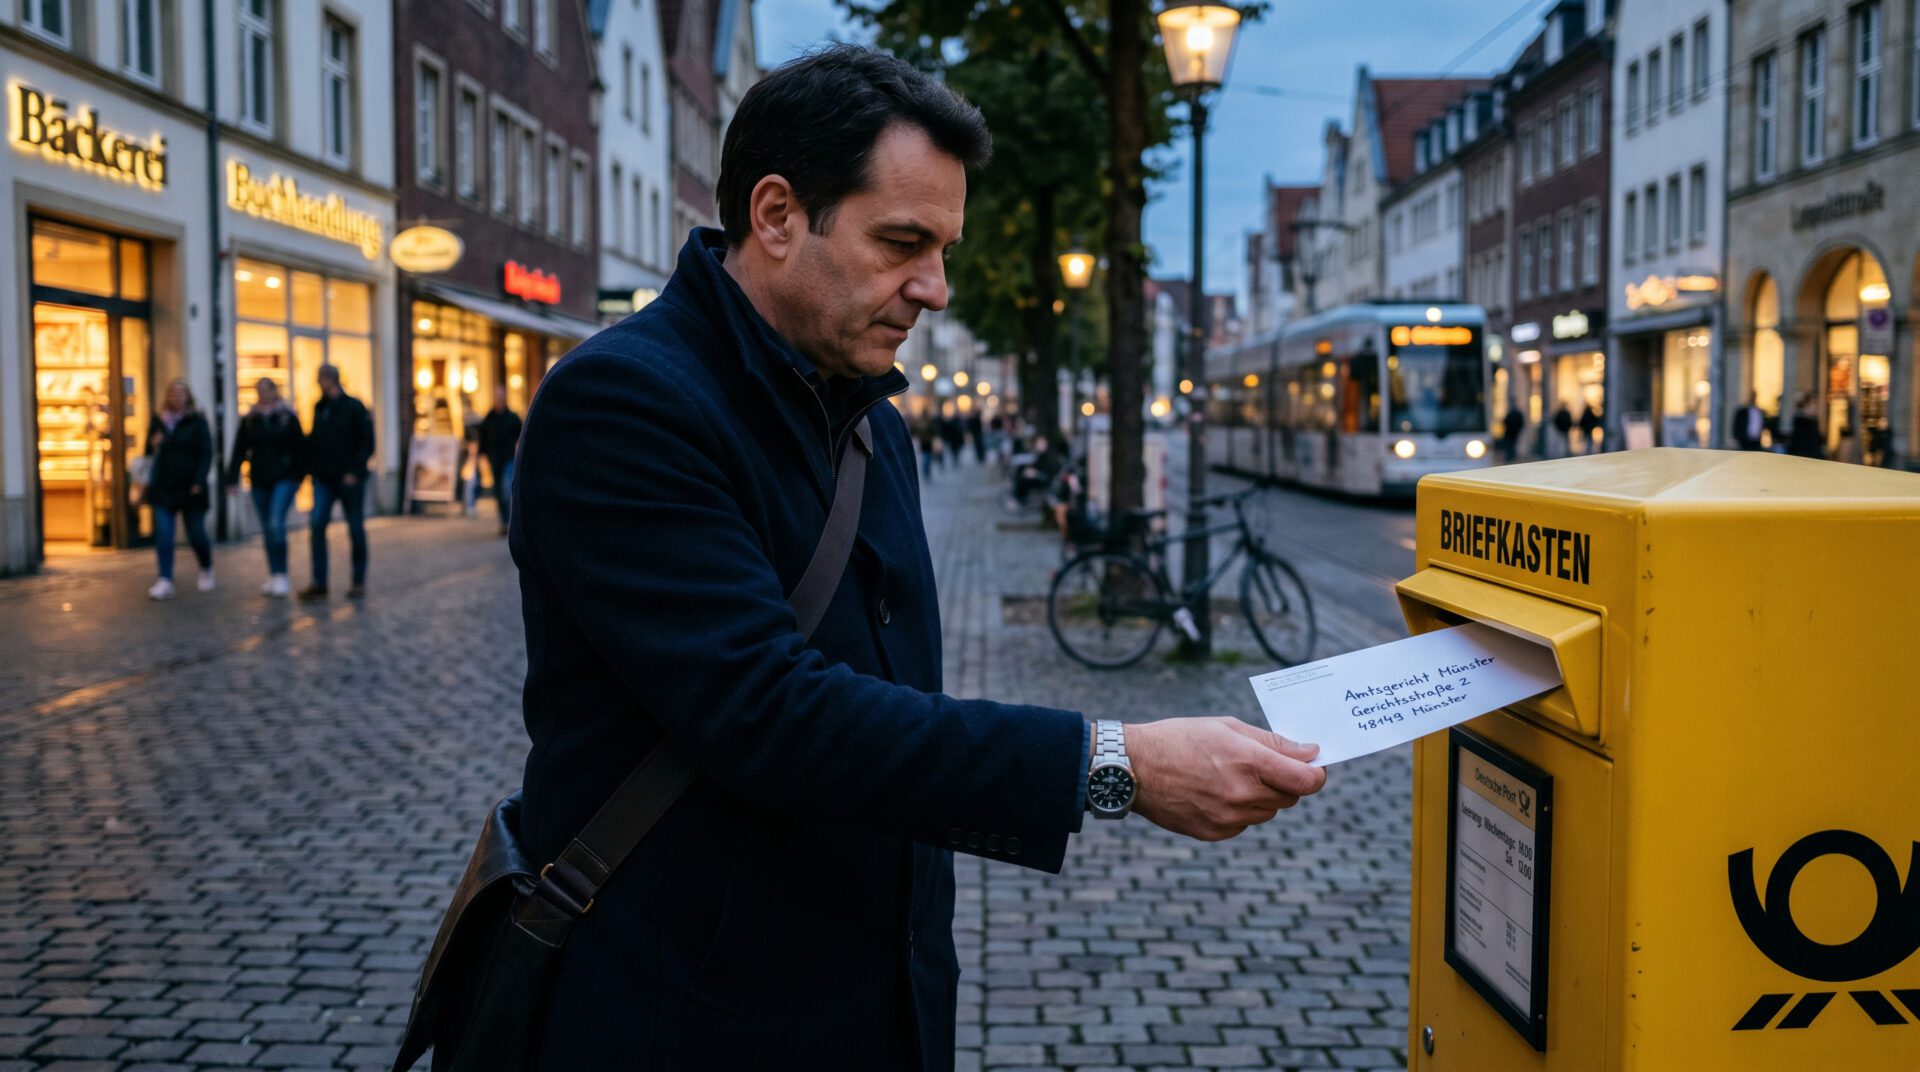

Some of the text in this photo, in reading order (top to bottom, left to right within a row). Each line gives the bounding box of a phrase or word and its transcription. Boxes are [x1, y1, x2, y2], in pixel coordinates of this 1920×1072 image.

[1440, 509, 1591, 585] BRIEFKASTEN
[1344, 672, 1430, 702] Amtsgericht
[1438, 655, 1496, 678] Münster
[1351, 683, 1455, 718] Gerichtsstraße
[1358, 693, 1468, 731] 48149 Münster
[1502, 783, 1517, 806] Post
